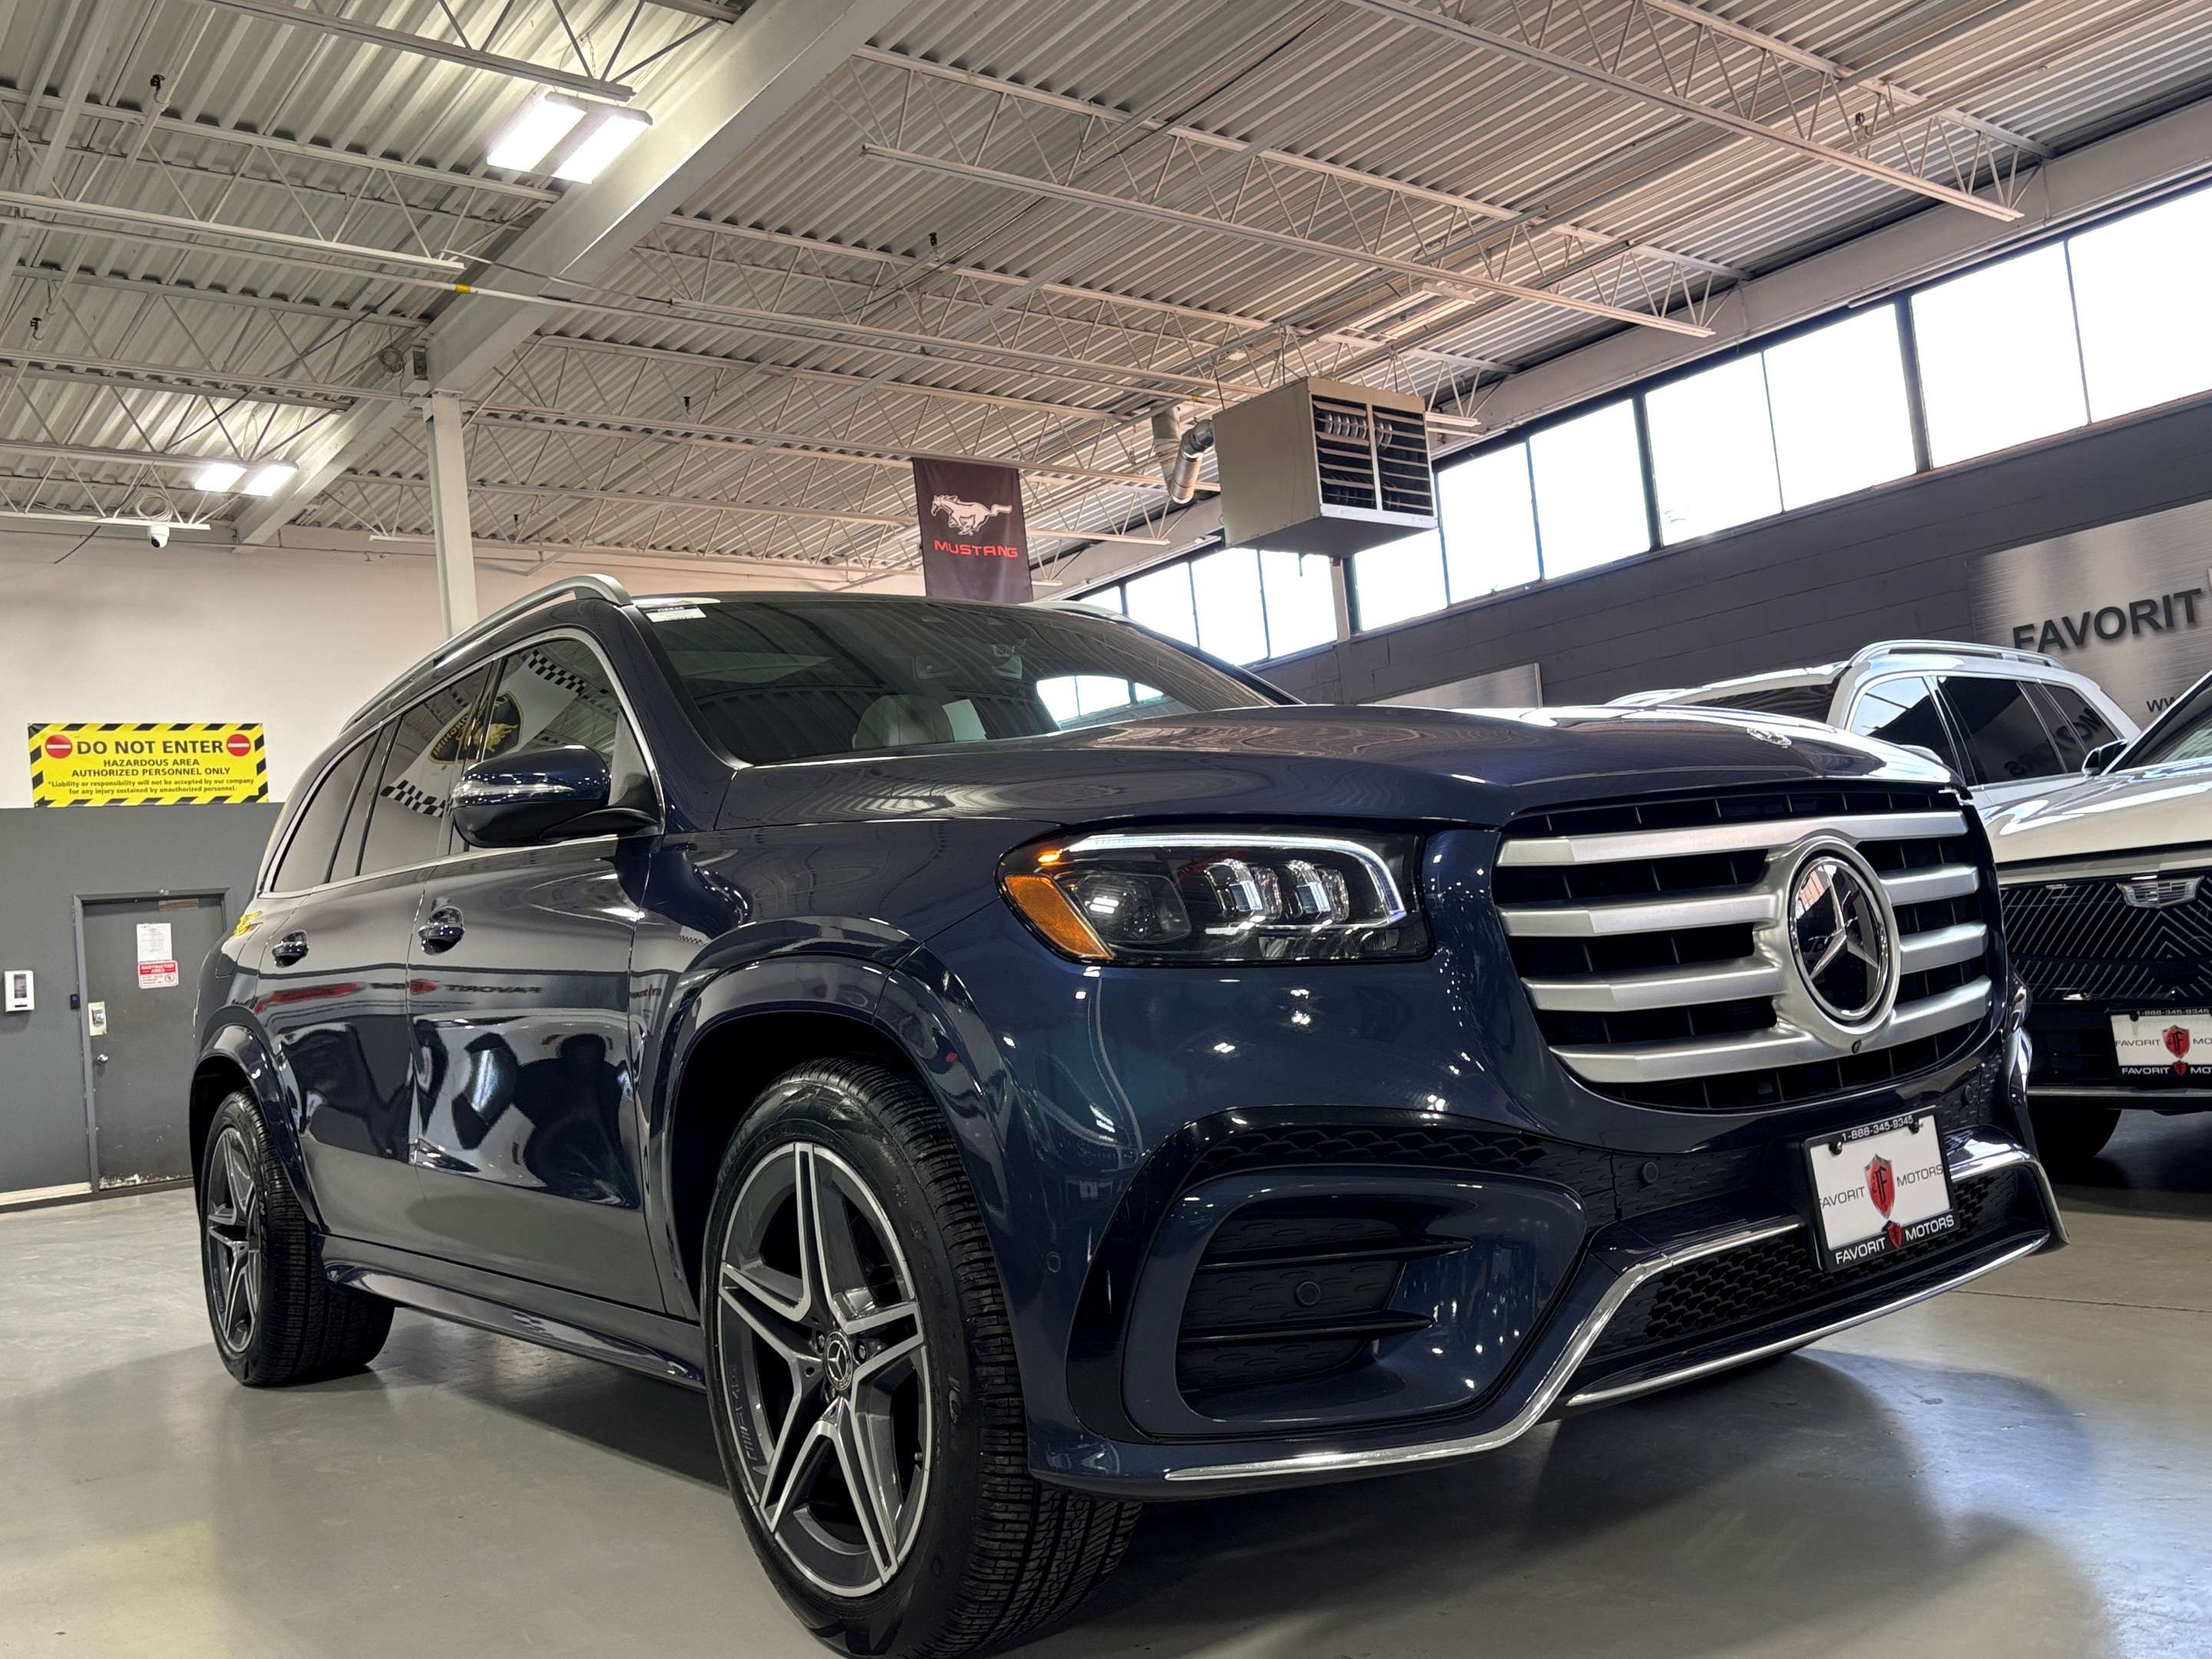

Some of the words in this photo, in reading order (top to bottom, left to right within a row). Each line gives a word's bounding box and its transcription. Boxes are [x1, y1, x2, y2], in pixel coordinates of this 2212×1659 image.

[934, 540, 1018, 558] MUSTANG
[2012, 588, 2202, 653] FAVORIT
[77, 740, 108, 754] DO
[115, 740, 155, 754] NOT
[162, 740, 224, 753] ENTER
[104, 759, 169, 767] HAZARDOUS
[172, 758, 200, 767] AREA
[71, 769, 139, 777] AUTHORIZED
[142, 768, 202, 777] PERSONNEL
[2121, 1066, 2171, 1075] FAVORIT
[2190, 1066, 2212, 1075] MO
[1842, 1115, 1913, 1141] 1-888-345-9345
[1896, 1164, 1944, 1187] MOTORS
[1835, 1237, 1886, 1265] FAVORIT
[1905, 1214, 1955, 1242] MOTORS
